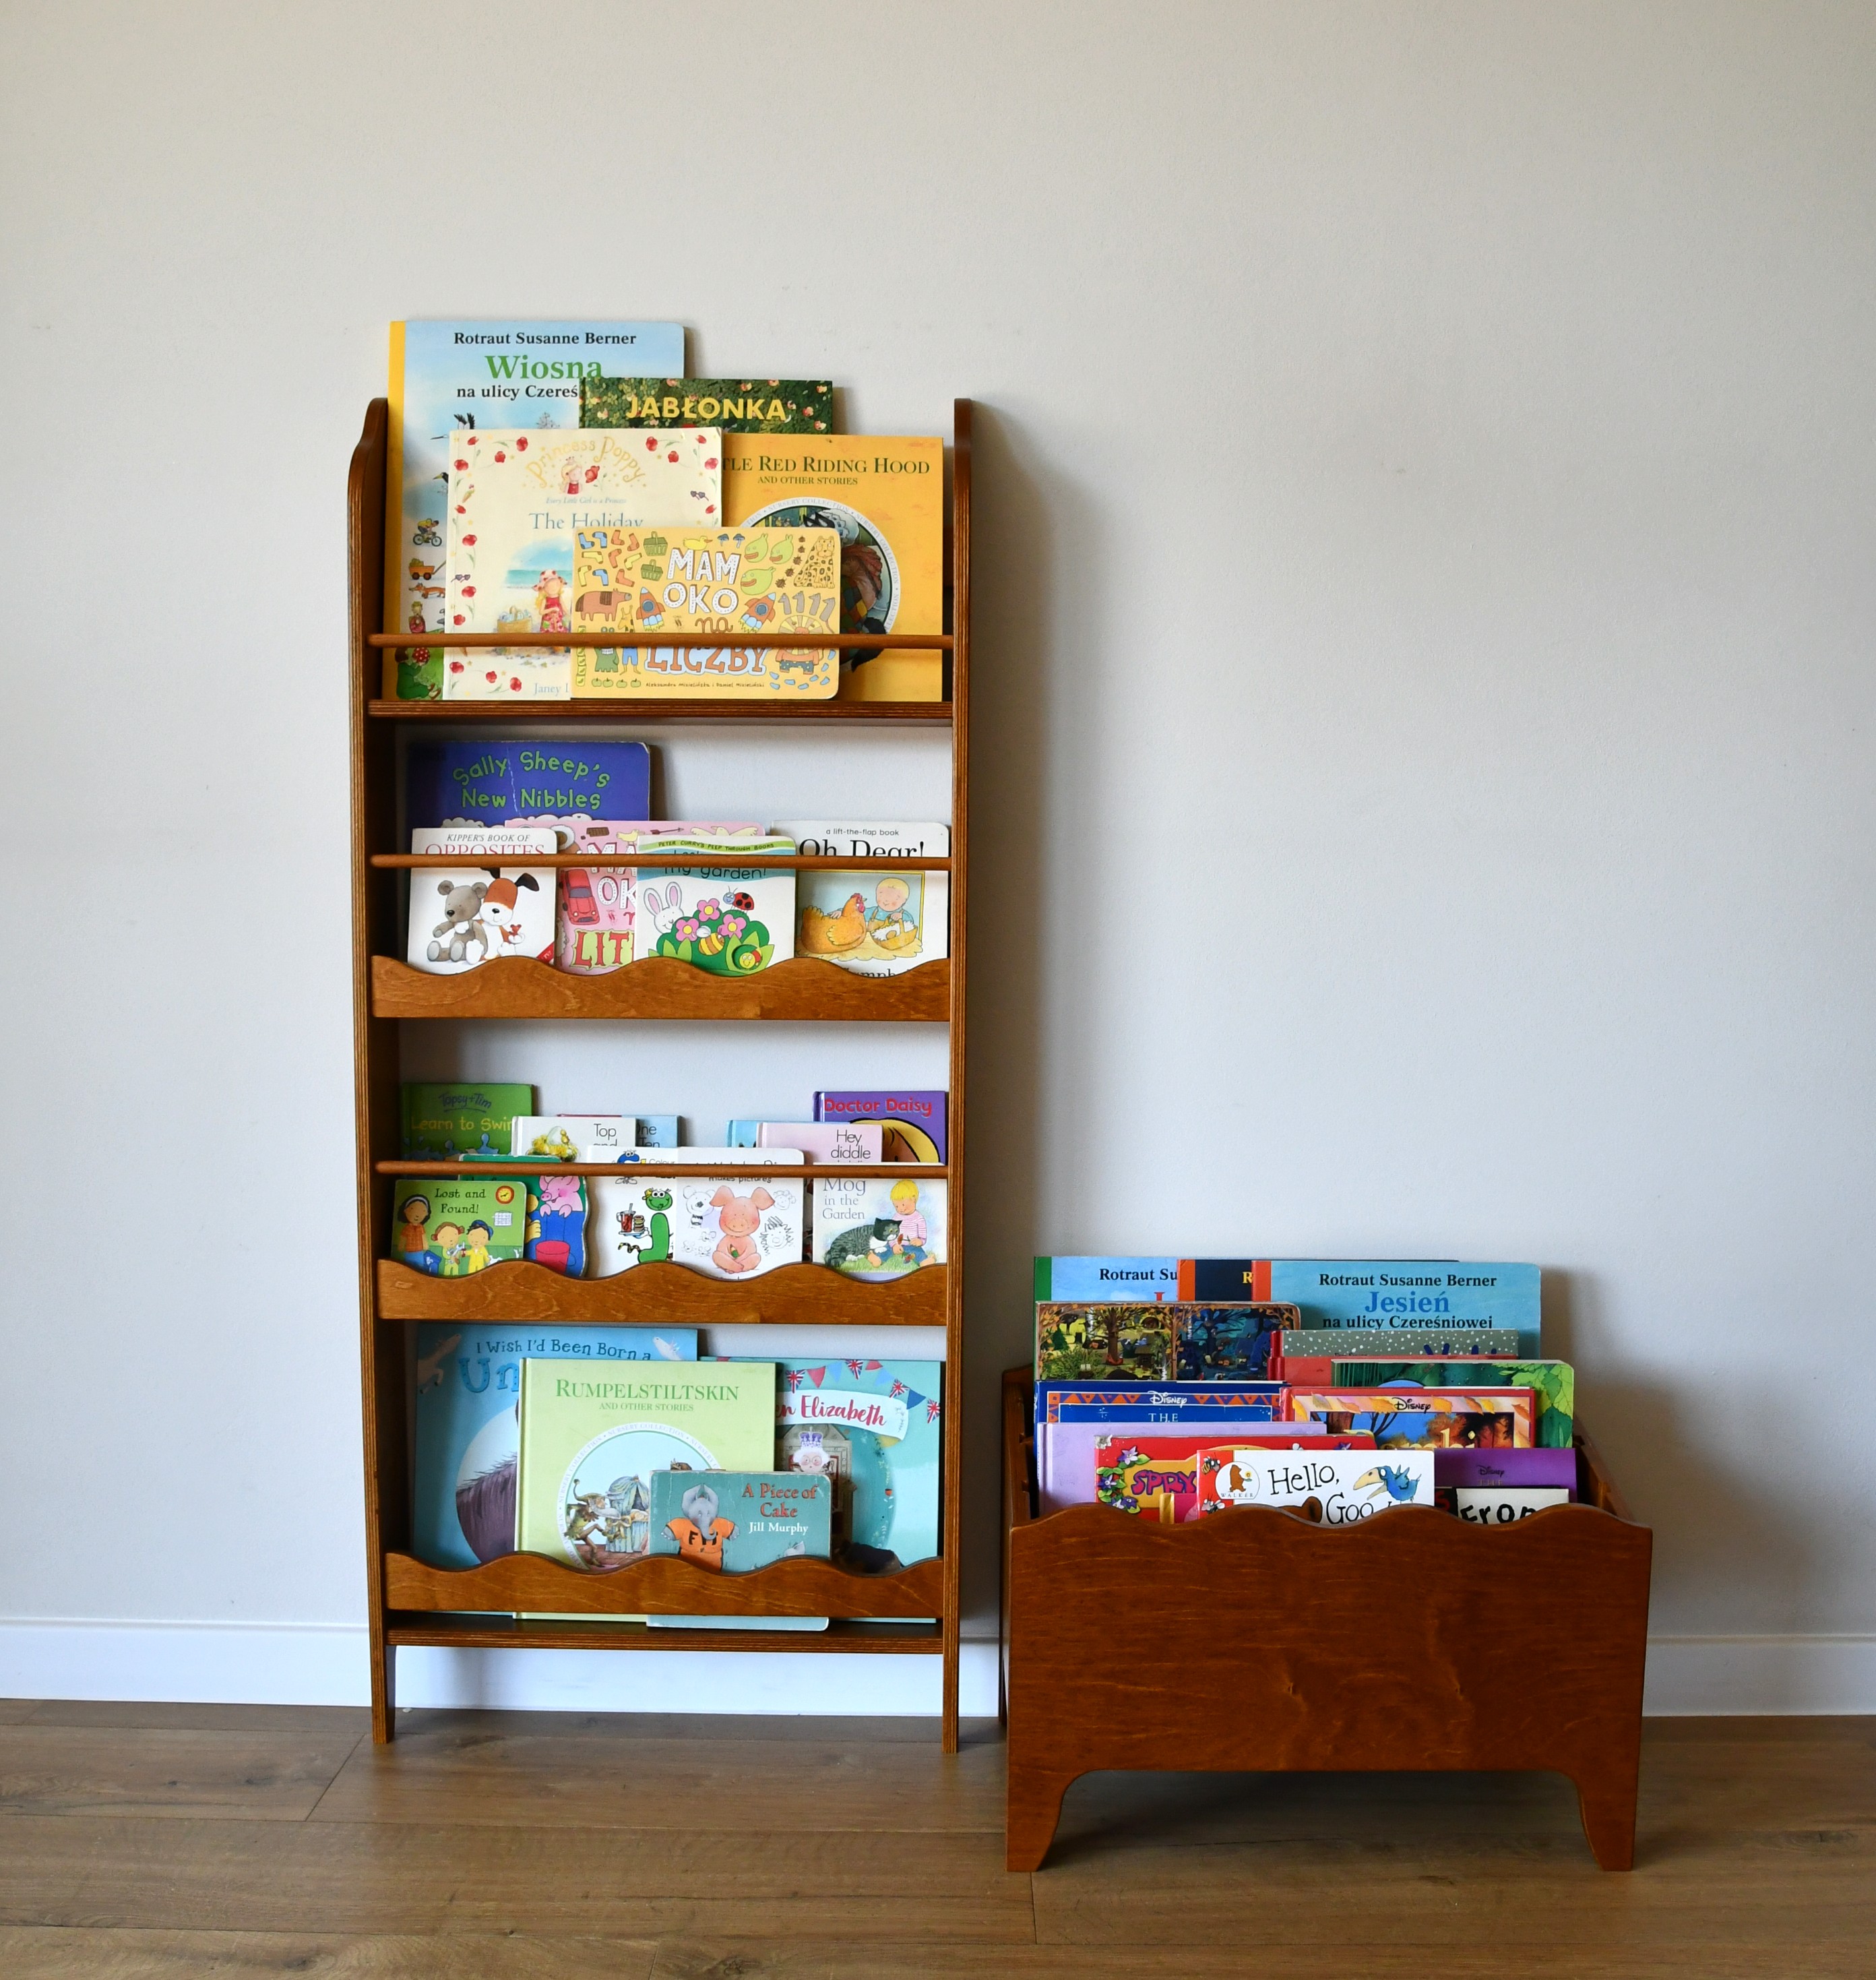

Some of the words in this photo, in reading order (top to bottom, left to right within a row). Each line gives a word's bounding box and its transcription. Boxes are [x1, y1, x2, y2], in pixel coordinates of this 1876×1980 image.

[454, 332, 511, 345] Rotraut
[515, 332, 580, 345] Susanne
[584, 332, 636, 345] Berner
[484, 354, 602, 379] Wiosna
[456, 388, 476, 398] na
[481, 385, 520, 402] ulicy
[626, 396, 787, 421] JABŁONKA
[526, 439, 596, 489] Princess
[593, 436, 646, 483] Poppy
[757, 476, 778, 485] AND
[780, 476, 815, 485] OTHER
[817, 476, 858, 486] STORIES
[529, 512, 565, 530] The
[666, 547, 741, 585] MAM
[662, 582, 739, 615] OKO
[694, 616, 734, 634] na
[452, 754, 507, 786] Sally
[519, 750, 611, 788] Sheep's
[461, 788, 507, 808] New
[520, 788, 601, 810] Nibbles
[447, 834, 485, 842] KIPPER'S
[487, 834, 514, 842] BOOK
[517, 834, 531, 842] OF
[833, 828, 877, 836] lift-the-flap
[754, 843, 774, 851] BOOKS
[799, 838, 838, 857] Oh
[700, 867, 767, 880] garden!
[823, 1097, 880, 1113] Doctor
[885, 1096, 933, 1119] Daisy
[411, 1116, 453, 1131] Learn
[460, 1115, 474, 1130] to
[593, 1123, 617, 1141] Top
[836, 1129, 863, 1147] Hey
[830, 1144, 871, 1159] diddle
[435, 1187, 461, 1199] Lost
[465, 1188, 487, 1199] and
[823, 1177, 867, 1197] Mog
[824, 1195, 838, 1206] in
[840, 1194, 859, 1206] the
[441, 1203, 480, 1214] Found!
[822, 1207, 866, 1220] Garden
[1099, 1268, 1156, 1281] Rotraut
[1319, 1273, 1375, 1286] Rotraut
[1379, 1274, 1442, 1287] Susanne
[1446, 1274, 1497, 1287] Berner
[1365, 1290, 1450, 1313] Jesień
[1323, 1318, 1341, 1328] na
[1346, 1315, 1384, 1330] ulicy
[1389, 1315, 1493, 1330] Czereśniowej
[476, 1342, 481, 1353] I
[486, 1339, 522, 1353] Wish
[527, 1338, 545, 1353] I'd
[551, 1338, 592, 1355] Been
[596, 1342, 637, 1360] Born
[642, 1352, 652, 1360] a
[555, 1378, 740, 1401] RUMPELSTILTSKIN
[599, 1402, 619, 1411] AND
[620, 1402, 652, 1411] OTHER
[654, 1402, 694, 1412] STORIES
[801, 1394, 887, 1426] Elizabeth
[1148, 1413, 1179, 1423] THE
[1268, 1462, 1340, 1495] Hello,
[742, 1483, 754, 1498] A
[760, 1483, 799, 1499] Piece
[801, 1483, 820, 1499] of
[760, 1503, 799, 1518] Cake
[749, 1522, 765, 1535] Jill
[768, 1522, 809, 1536] Murphy
